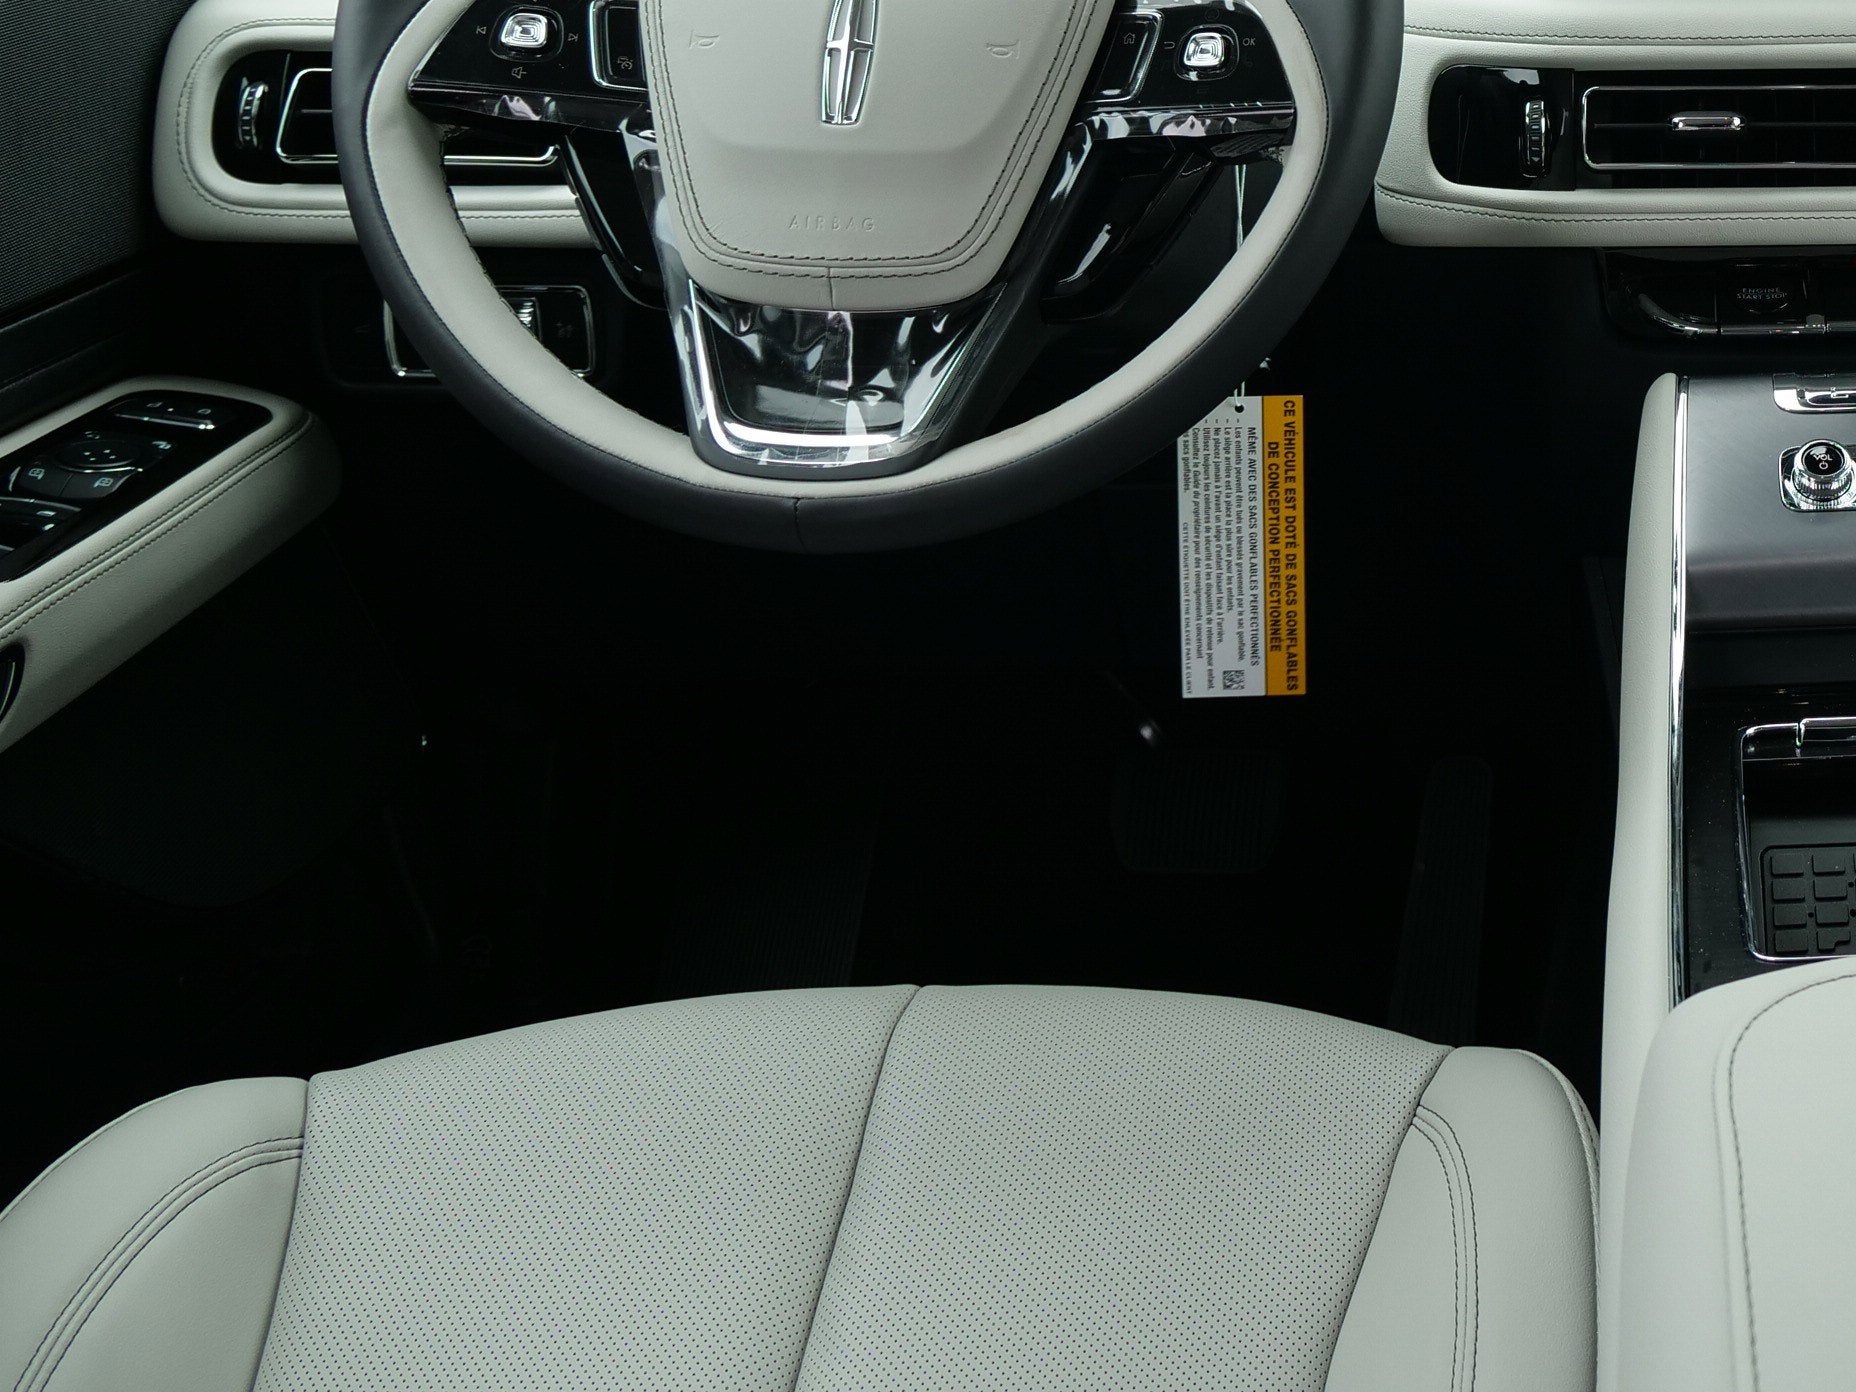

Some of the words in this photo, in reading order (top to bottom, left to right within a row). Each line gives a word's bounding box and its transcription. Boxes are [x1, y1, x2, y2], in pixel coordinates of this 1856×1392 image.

[1242, 37, 1256, 47] OK
[788, 214, 874, 232] AIRBAG
[1766, 292, 1788, 300] STOP
[1284, 400, 1295, 417] CE
[1235, 440, 1243, 465] enfants
[1248, 427, 1258, 455] MÊME
[1268, 442, 1279, 458] DE
[1284, 421, 1298, 484] VÉHICULE
[1248, 458, 1256, 481] AVEC
[1814, 453, 1833, 463] VOL
[1233, 467, 1242, 496] peuvent
[1248, 485, 1257, 502] DES
[1268, 463, 1280, 544] CONCEPTION
[1285, 488, 1296, 510] EST
[1249, 505, 1257, 529] SACS
[1236, 526, 1242, 534] ou
[1285, 516, 1299, 548] DOTÉ
[1236, 536, 1244, 560] blessés
[1249, 532, 1258, 590] GONFLABLES
[1285, 554, 1297, 570] DE
[1235, 562, 1244, 597] gravement
[1286, 574, 1297, 606] SACS
[1235, 598, 1244, 608] par
[1270, 549, 1283, 652] PERFECTIONNÉE
[1250, 594, 1260, 666] PERFECTIONNÉS
[1286, 610, 1298, 691] GONFLABLES
